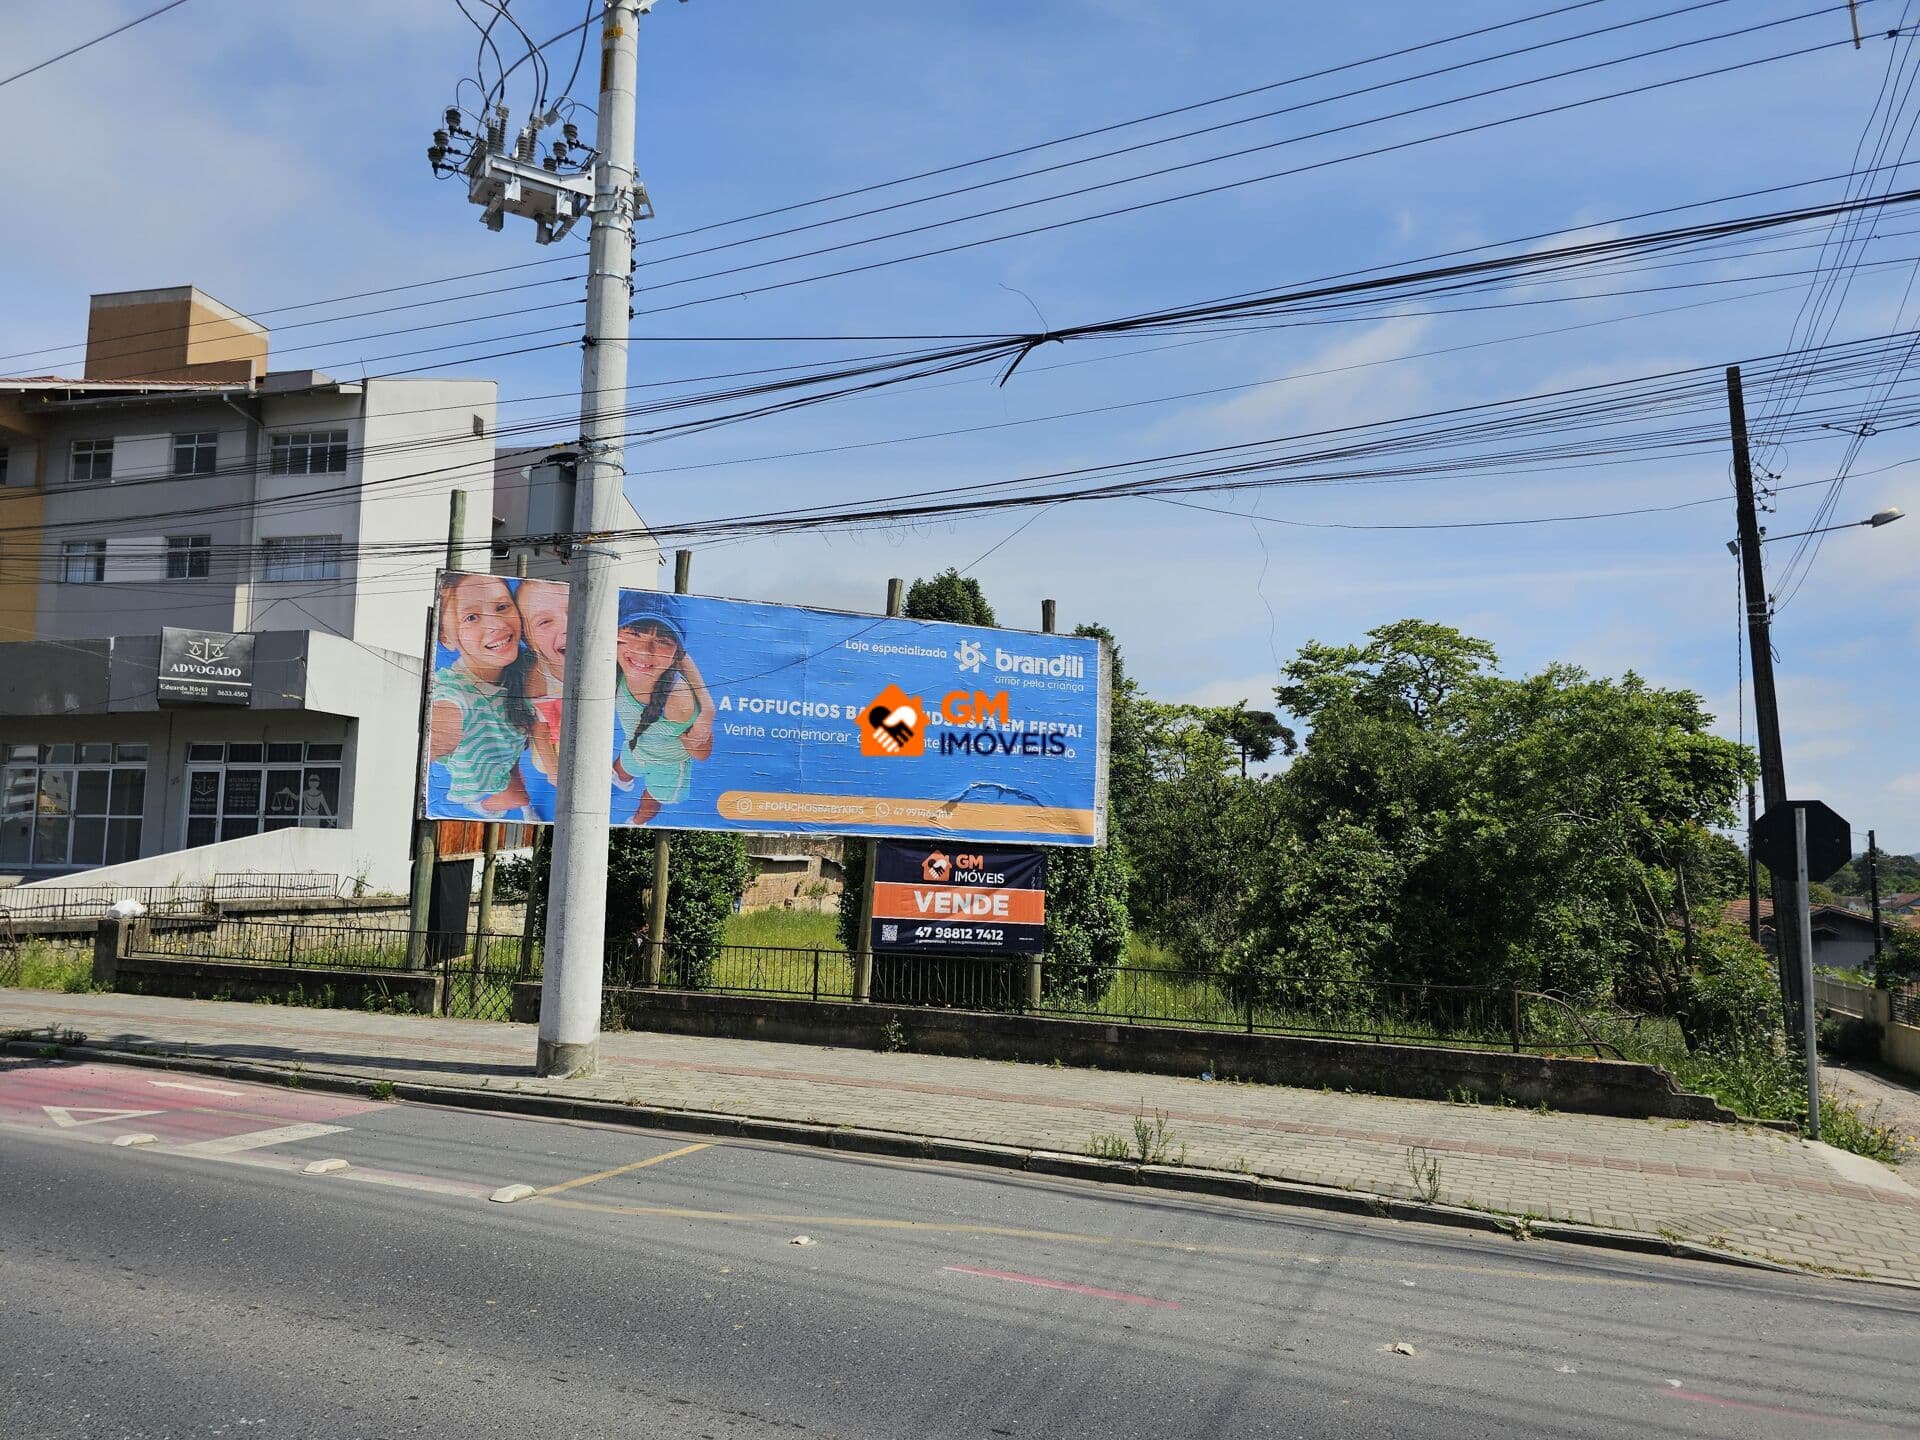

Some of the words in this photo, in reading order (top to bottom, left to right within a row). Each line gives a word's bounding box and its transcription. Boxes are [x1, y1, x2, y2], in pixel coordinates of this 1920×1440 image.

[845, 639, 869, 653] Loja
[872, 643, 947, 659] especializada
[170, 664, 242, 677] ADVOGADO
[995, 647, 1084, 679] brandili
[160, 683, 188, 692] Eduardo
[1022, 678, 1045, 689] pela
[1047, 681, 1084, 693] criança
[718, 695, 733, 711] A
[738, 697, 840, 720] FOFUCHOS
[723, 722, 765, 738] Venha
[770, 725, 852, 744] comemorar
[956, 853, 984, 870] GM
[954, 869, 1005, 885] IMÓVEIS
[913, 890, 1010, 917] VENDE
[914, 926, 933, 938] 47
[935, 927, 973, 939] 98812
[975, 929, 1004, 941] 7412
